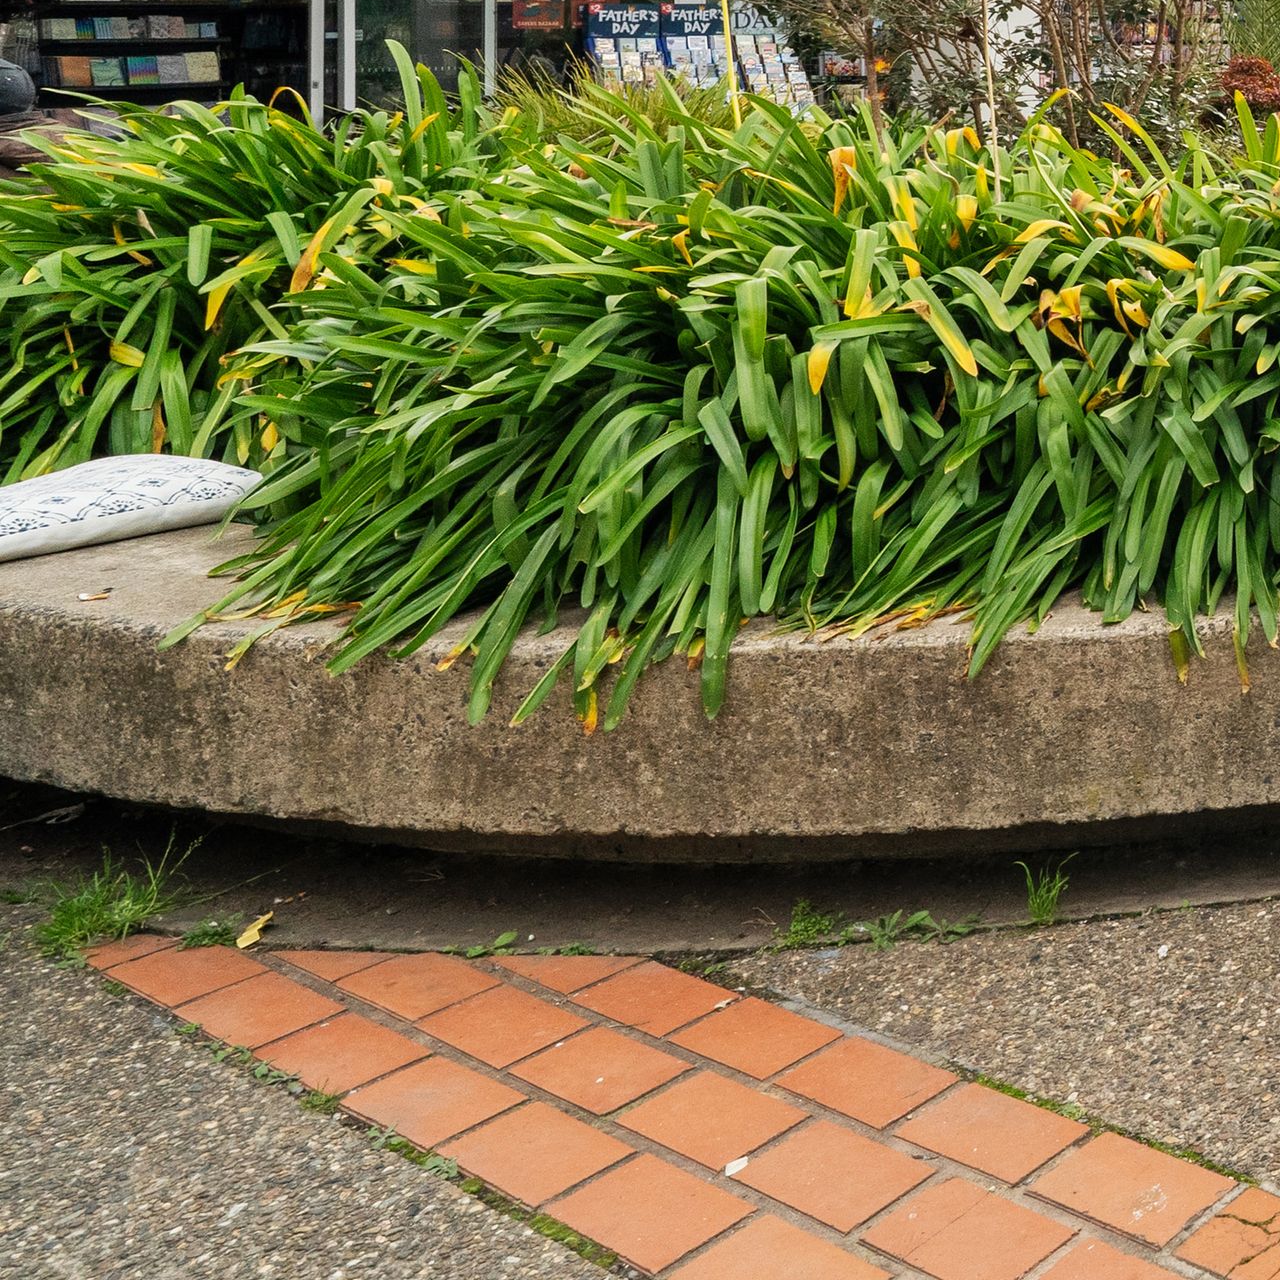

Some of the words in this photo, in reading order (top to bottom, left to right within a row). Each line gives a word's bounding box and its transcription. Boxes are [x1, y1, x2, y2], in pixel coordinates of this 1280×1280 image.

[599, 9, 659, 23] FATHER'S
[734, 11, 770, 29] DA
[612, 22, 640, 35] DAY
[684, 21, 711, 34] DAY
